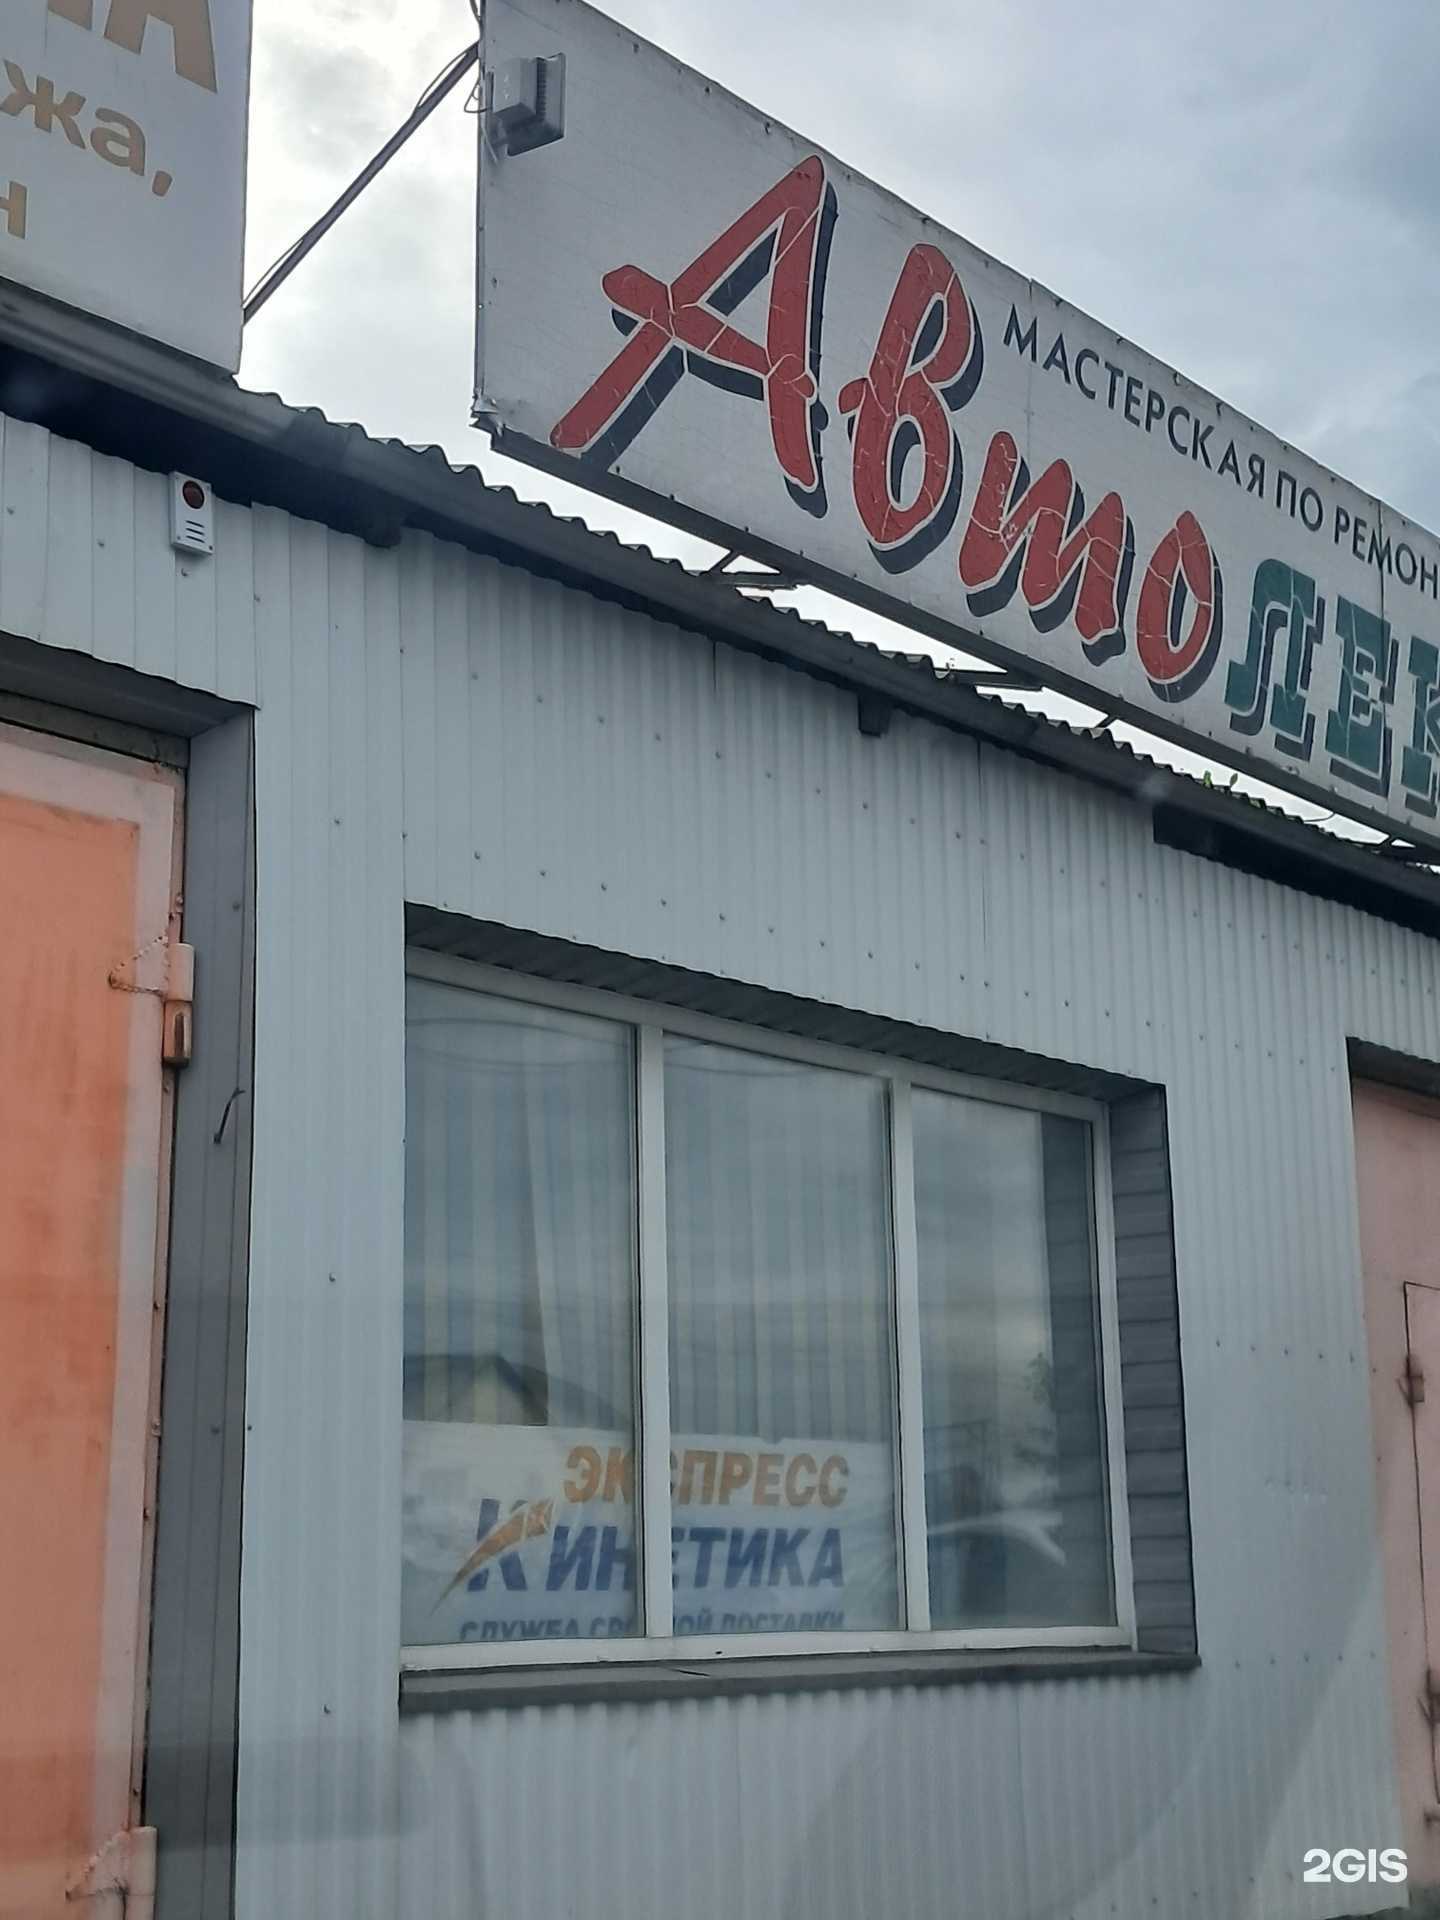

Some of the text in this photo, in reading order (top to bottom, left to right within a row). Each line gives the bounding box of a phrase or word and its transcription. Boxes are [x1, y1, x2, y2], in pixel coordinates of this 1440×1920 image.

[1003, 303, 1438, 600] МАСТЕРСКАЯ ПО РЕМОН
[562, 1445, 849, 1508] ЭКПРЕСС
